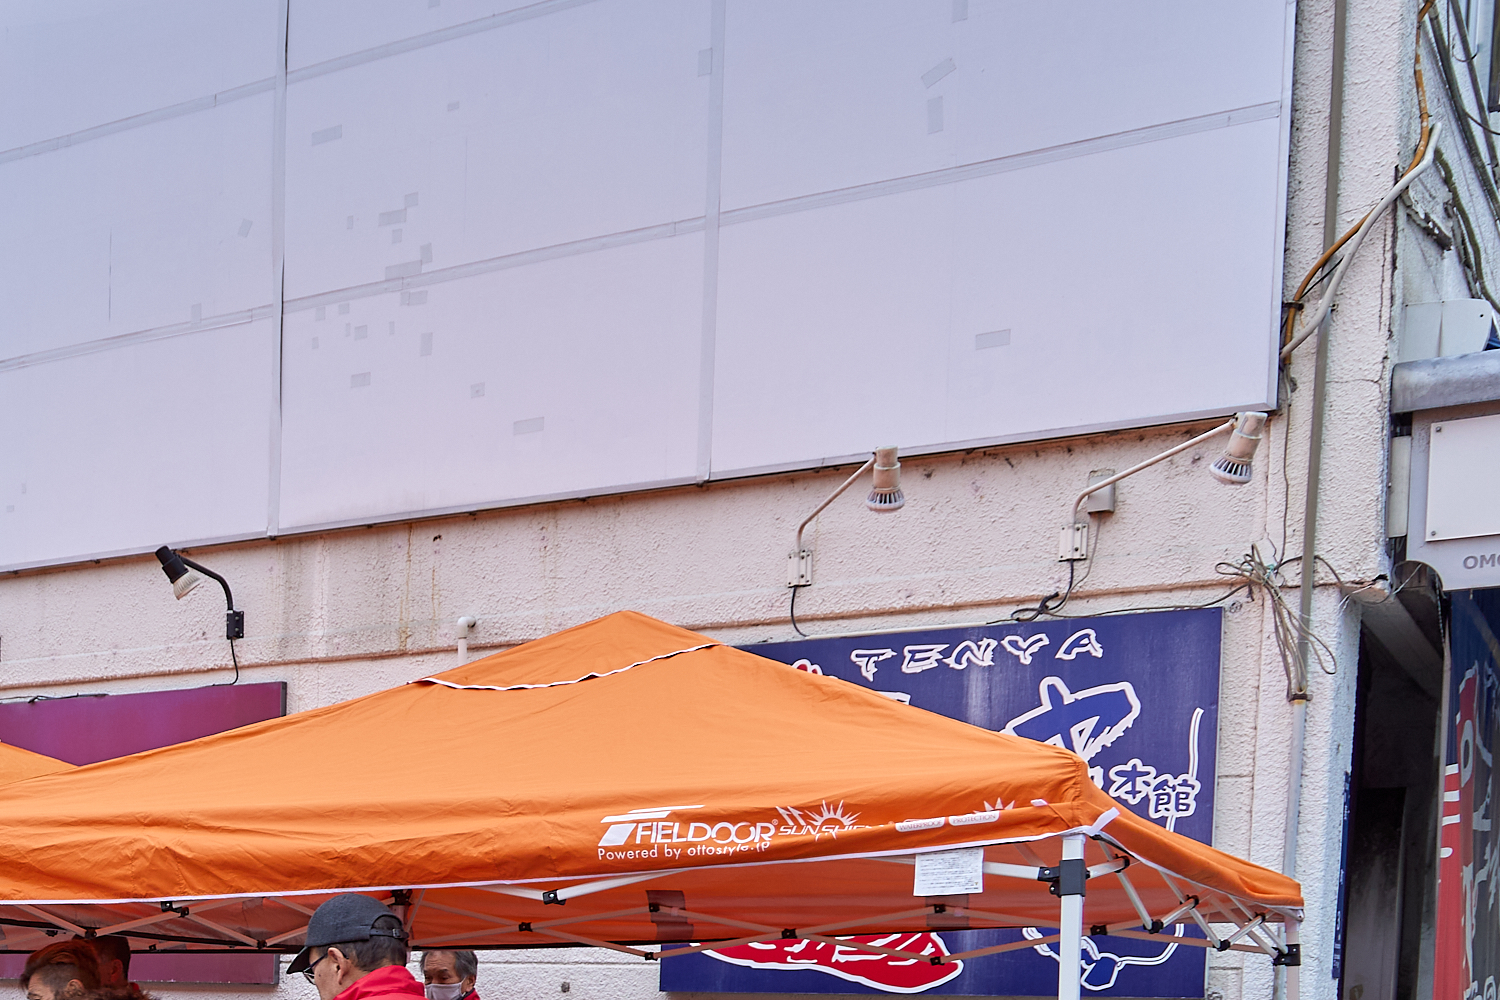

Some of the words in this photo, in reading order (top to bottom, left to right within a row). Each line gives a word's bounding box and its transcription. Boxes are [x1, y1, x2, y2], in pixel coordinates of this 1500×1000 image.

[850, 628, 1104, 682] TENYA
[635, 821, 776, 845] FIELDOOR
[597, 844, 658, 861] Powered
[664, 843, 682, 860] by
